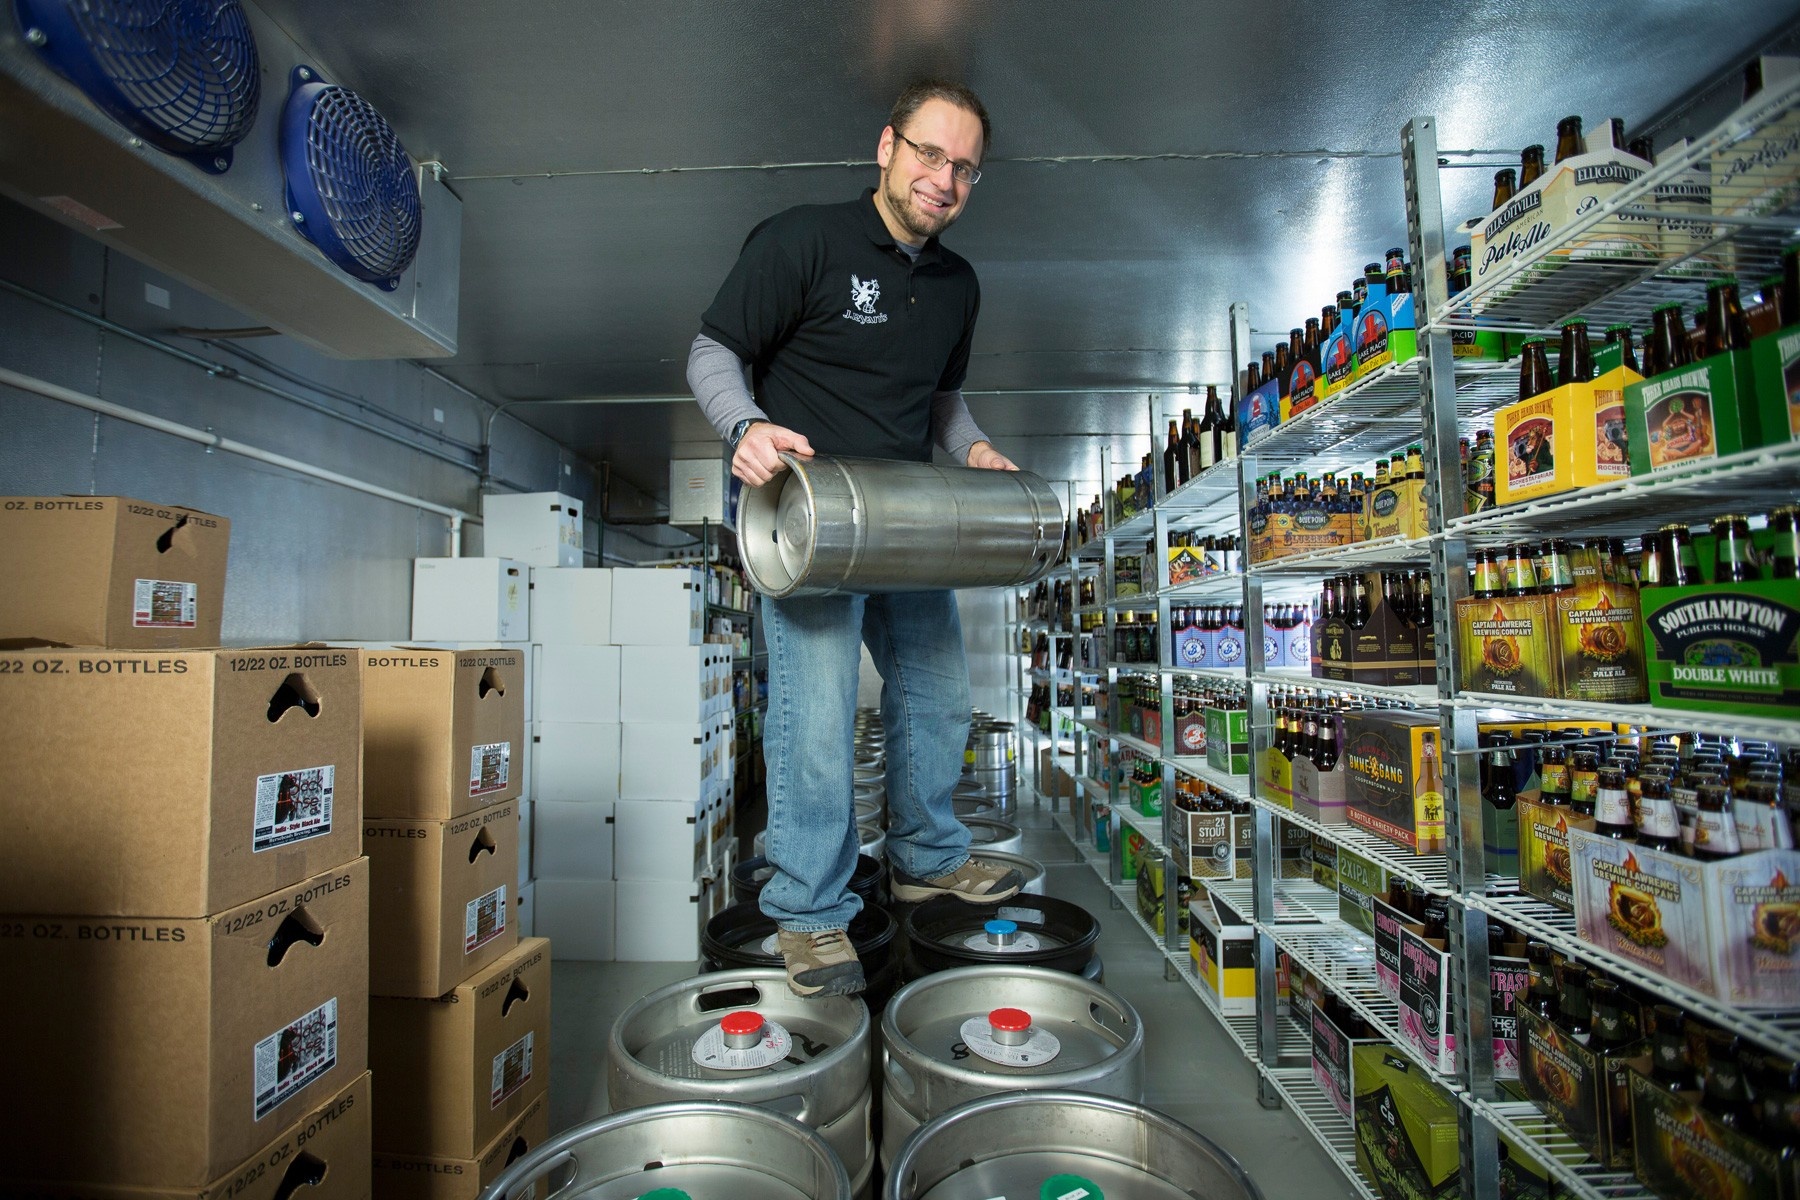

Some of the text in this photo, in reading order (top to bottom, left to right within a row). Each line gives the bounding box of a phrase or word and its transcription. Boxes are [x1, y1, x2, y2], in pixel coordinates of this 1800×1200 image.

[1577, 166, 1646, 181] ELLICOTTVIL
[1486, 192, 1540, 237] ELLICOTTVILLE
[1516, 209, 1544, 231] AMERICAN
[1479, 221, 1551, 275] Pale Ale
[1359, 340, 1387, 360] LAKE PLACID
[1461, 347, 1473, 355] Ale
[1359, 355, 1388, 374] India Pale Ale
[1328, 369, 1341, 380] LAKE
[1329, 384, 1341, 394] India
[1642, 367, 1711, 407] THREE HEADS BREWING
[1594, 389, 1614, 408] THREE
[5, 501, 103, 510] OZ. BOTTLES
[127, 505, 154, 517] 12/22
[157, 510, 173, 520] OZ.
[1374, 518, 1400, 537] Toasted
[1568, 608, 1633, 618] CAPTAIN LAWRENCE
[1658, 600, 1788, 634] SOUTHAMPTON
[1472, 620, 1532, 629] CAPTAIN LAWRENCE
[1501, 628, 1532, 636] COMPANY
[1676, 623, 1766, 639] PUBLICK HOUSE
[33, 660, 69, 673] OZ.
[80, 660, 187, 673] BOTTLES
[230, 654, 347, 671] 12/22 OZ. BOTTLES
[368, 658, 439, 667] BOTTLES
[460, 657, 516, 667] 12/22 OZ. BOTTLES
[1673, 668, 1779, 685] DOUBLE WHITE
[1355, 775, 1386, 789] COOPERSTOWN
[451, 808, 511, 835] 12/22 OZ. BOTTLES
[1215, 817, 1225, 827] 2X
[1534, 822, 1560, 837] CAPTAIN
[1199, 827, 1226, 838] STOUT
[1288, 829, 1308, 839] STOU
[1394, 828, 1409, 840] PACK
[1535, 831, 1564, 845] BREWING
[1592, 858, 1680, 893] CAPTAIN LAWRENCE
[1595, 867, 1680, 903] BREWING COMPANY
[1735, 886, 1776, 896] CAPTAIN
[225, 874, 350, 934] 12/22 OZ. BOTTLES
[1552, 891, 1567, 902] PALE
[33, 925, 69, 939] OZ.
[78, 926, 186, 942] BOTTLES
[1379, 948, 1399, 969] SOUT
[1403, 941, 1438, 977] EUROTRASH
[481, 981, 499, 999] 12/22
[513, 952, 542, 978] BOTTLES
[1528, 1029, 1583, 1075] CAPTAIN LAWRENCE
[1529, 1037, 1583, 1082] BREWING COMPANY
[226, 1094, 354, 1199] 12/22 OZ. BOTTLES
[392, 1161, 463, 1175] BOTTLES
